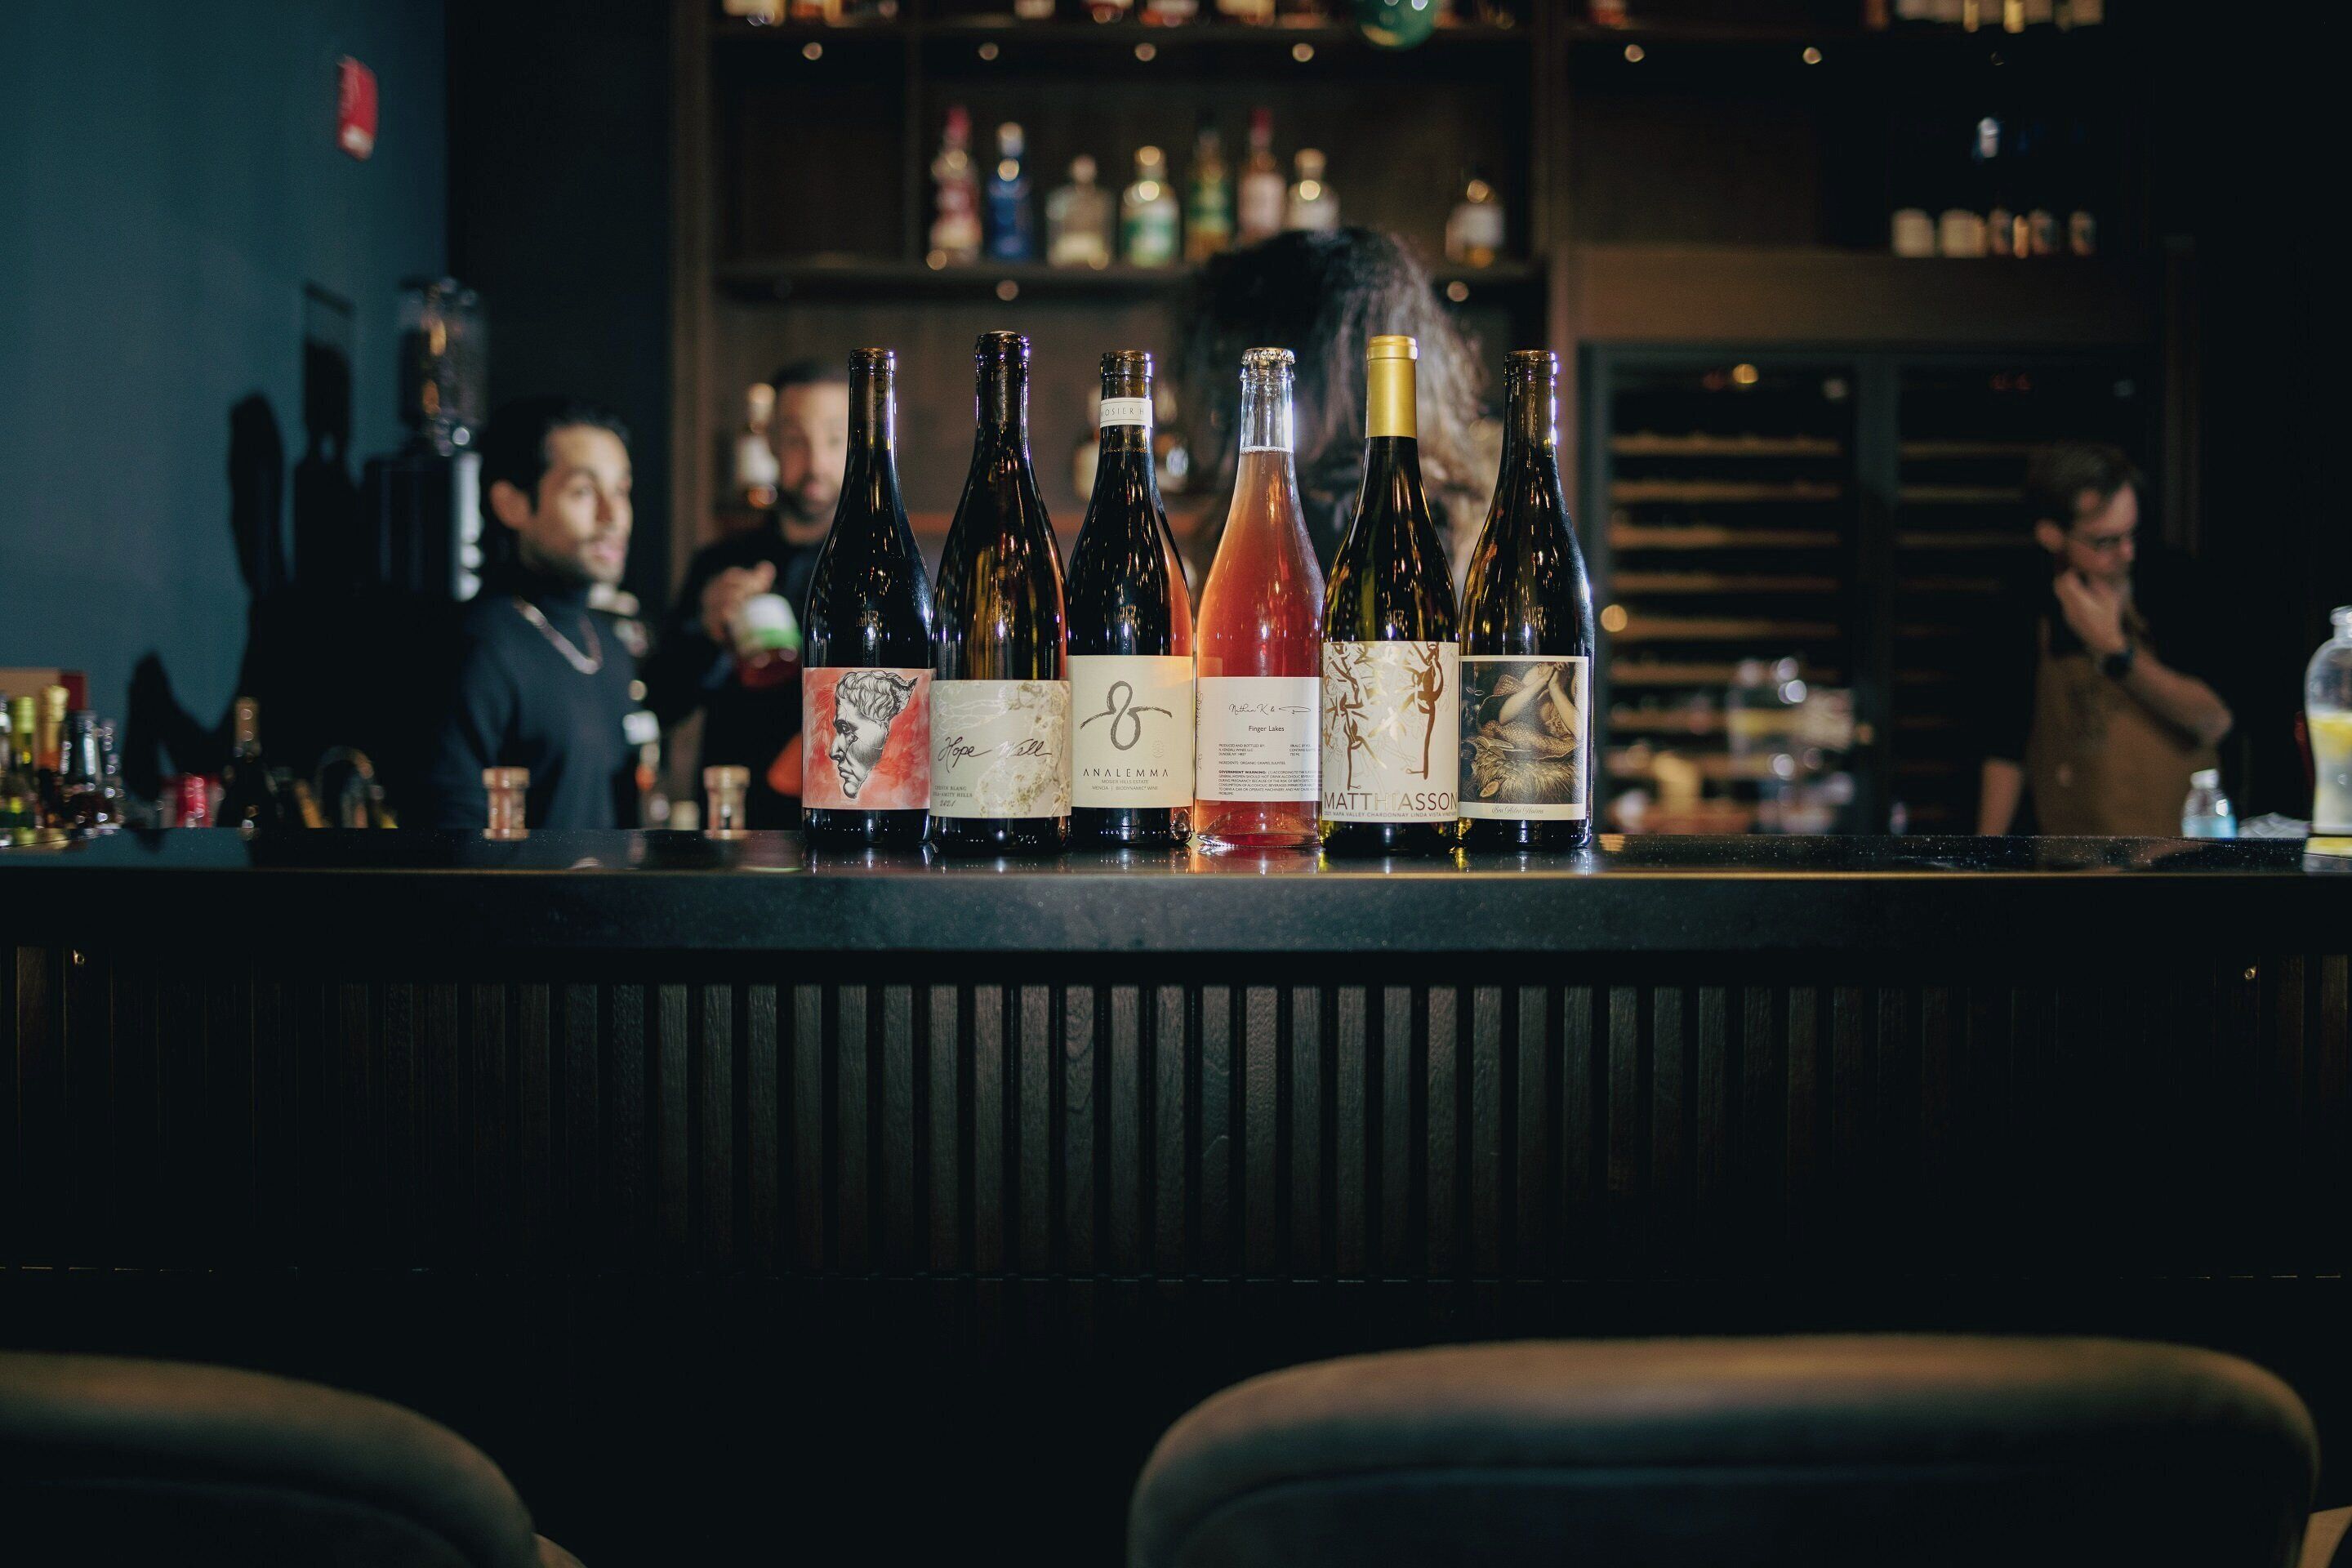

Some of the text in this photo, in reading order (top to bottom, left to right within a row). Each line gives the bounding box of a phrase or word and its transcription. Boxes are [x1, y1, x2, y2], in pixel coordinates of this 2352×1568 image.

[938, 737, 993, 773] Hope
[1083, 768, 1168, 777] ANALEMMA
[1324, 792, 1457, 811] MATTHIASSON
